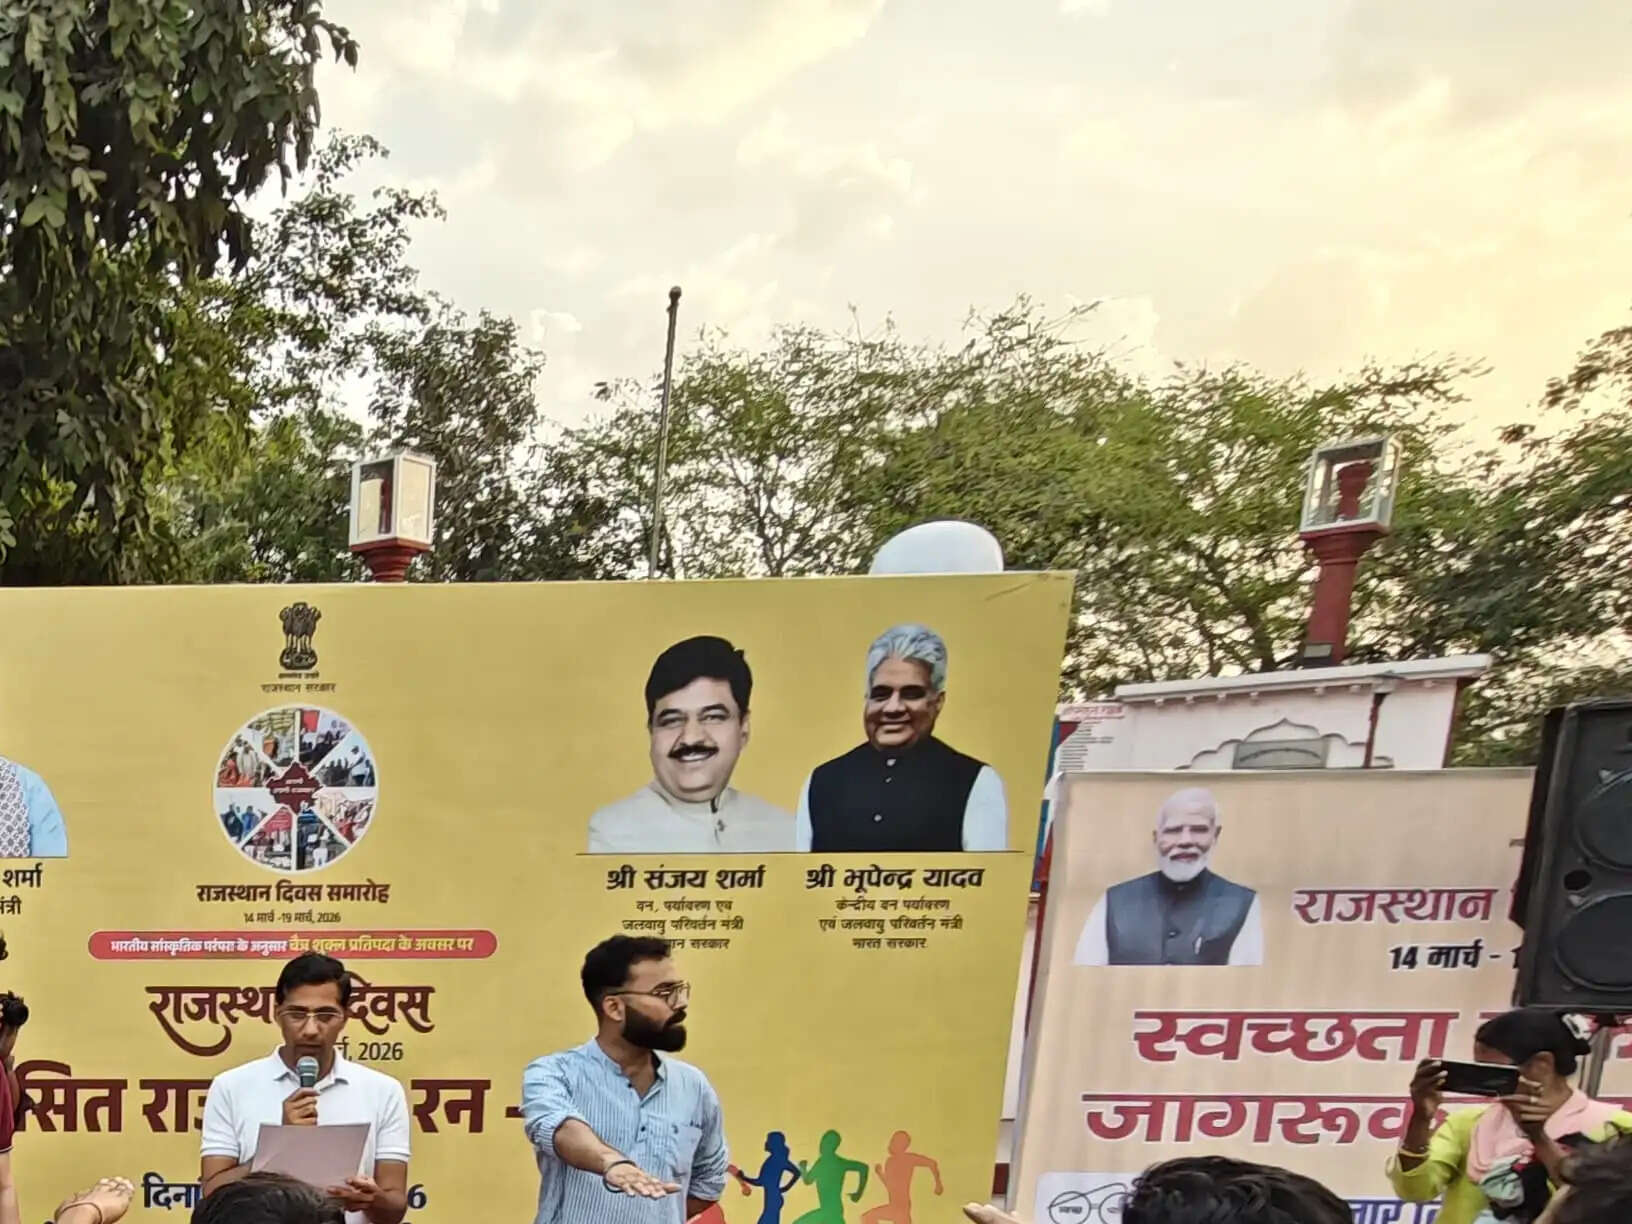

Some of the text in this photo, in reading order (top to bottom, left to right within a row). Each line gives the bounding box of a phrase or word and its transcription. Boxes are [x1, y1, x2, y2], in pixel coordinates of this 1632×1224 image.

[2, 862, 43, 888] शर्मा
[606, 864, 766, 890] श्री संजय शर्मा
[806, 864, 985, 893] श्री भूपेन्द्र यादव
[196, 878, 390, 903] राजस्थान दिवस समारोह
[664, 897, 710, 912] पर्यावरण
[880, 899, 898, 911] वन
[903, 896, 950, 911] पर्यावरण
[1294, 889, 1499, 923] राजस्थान
[244, 912, 254, 923] 14
[257, 909, 274, 922] मार्च
[317, 912, 341, 923] 2026
[622, 916, 744, 935] जलवायु परिवर्तन मंत्री
[818, 915, 963, 935] एवं जलवायु परिवर्तन मंत्री
[111, 937, 148, 952] भारतीय
[236, 937, 248, 952] के
[251, 940, 287, 957] अनुसार
[349, 935, 395, 952] प्रतिपदा
[398, 935, 412, 951] के
[415, 938, 453, 951] अवसर
[456, 938, 474, 951] पर
[691, 938, 730, 950] सरकार
[852, 937, 927, 950] भारत सरकार
[1389, 946, 1418, 969] 14
[1426, 939, 1483, 968] मार्च
[145, 986, 276, 1057] राजस्था
[1134, 1011, 1459, 1062] स्वच्छता
[358, 1042, 404, 1060] 2026
[12, 1060, 128, 1132] सित
